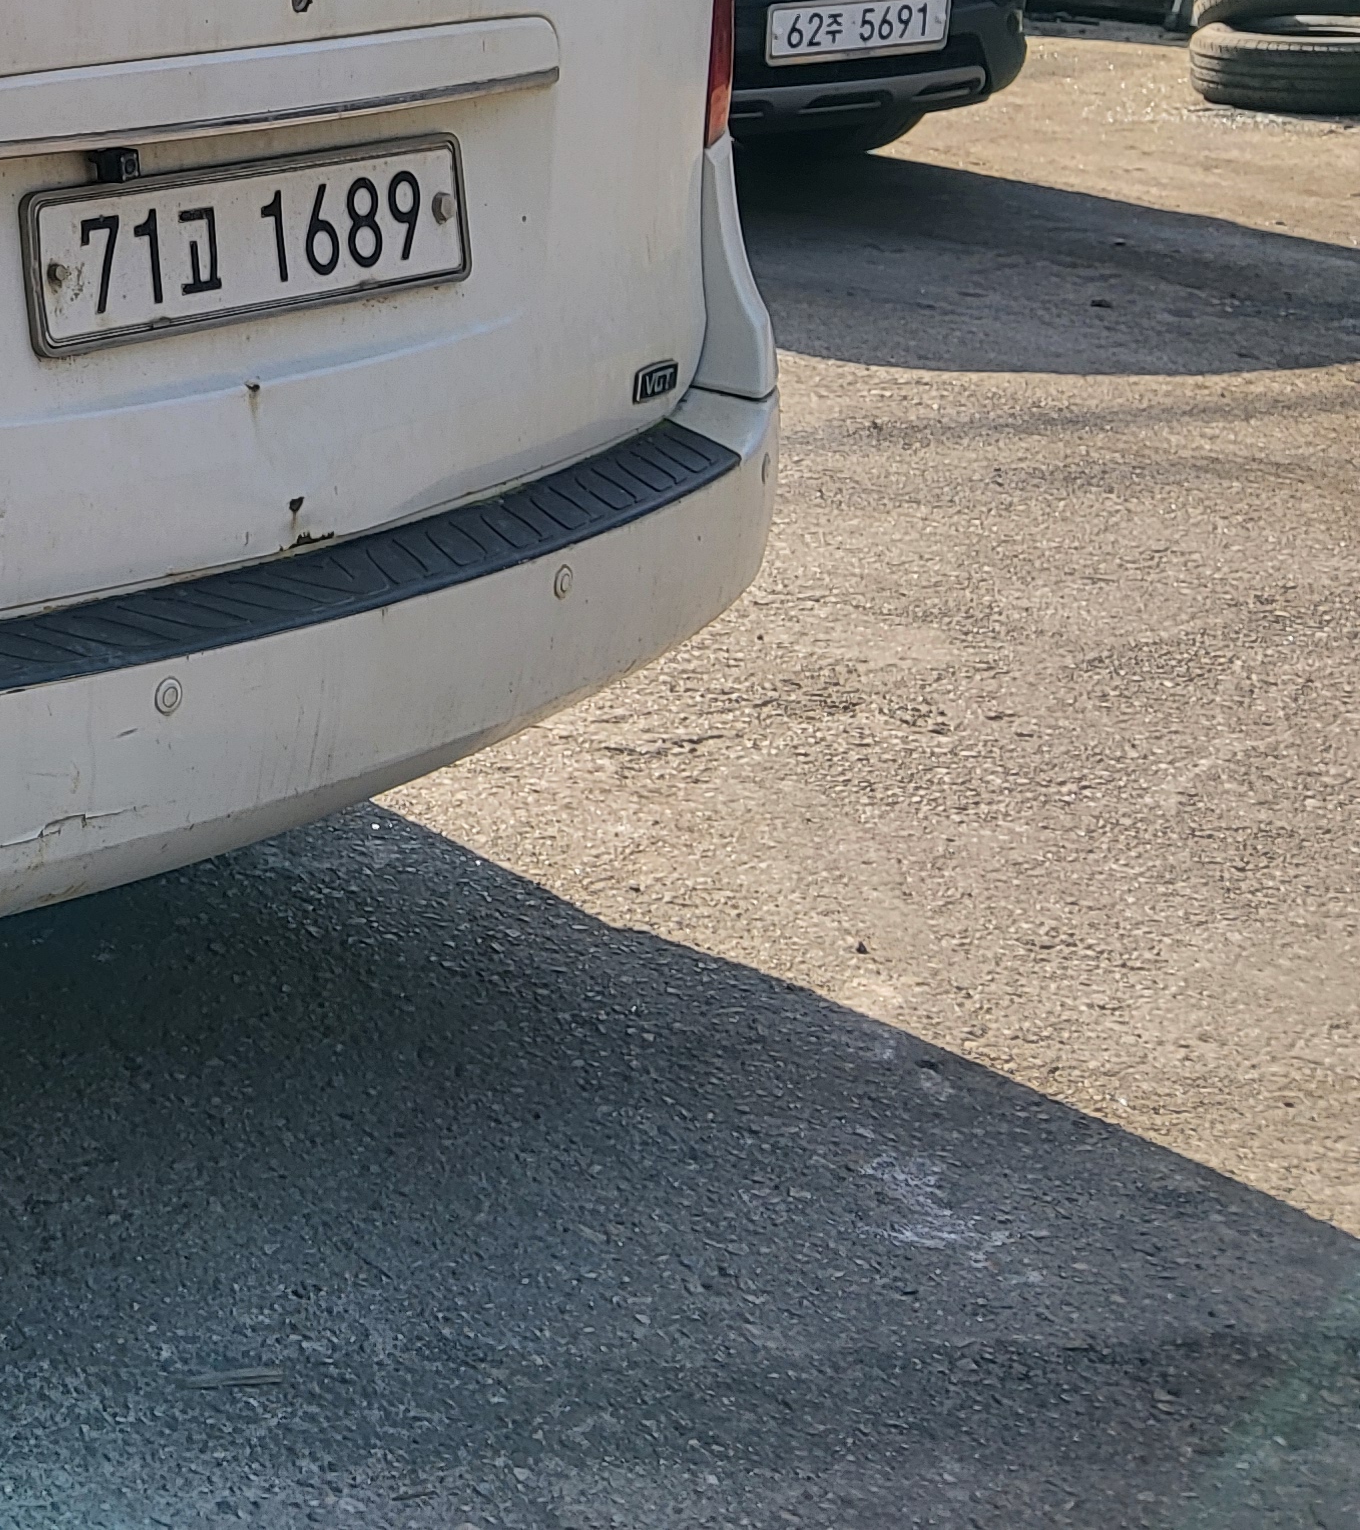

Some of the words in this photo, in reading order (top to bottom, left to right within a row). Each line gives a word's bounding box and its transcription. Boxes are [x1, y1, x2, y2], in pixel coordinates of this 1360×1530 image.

[786, 12, 844, 49] 62주
[858, 2, 928, 44] 5691
[80, 206, 223, 316] 71고
[260, 170, 422, 284] 1689
[645, 368, 676, 396] VGT
